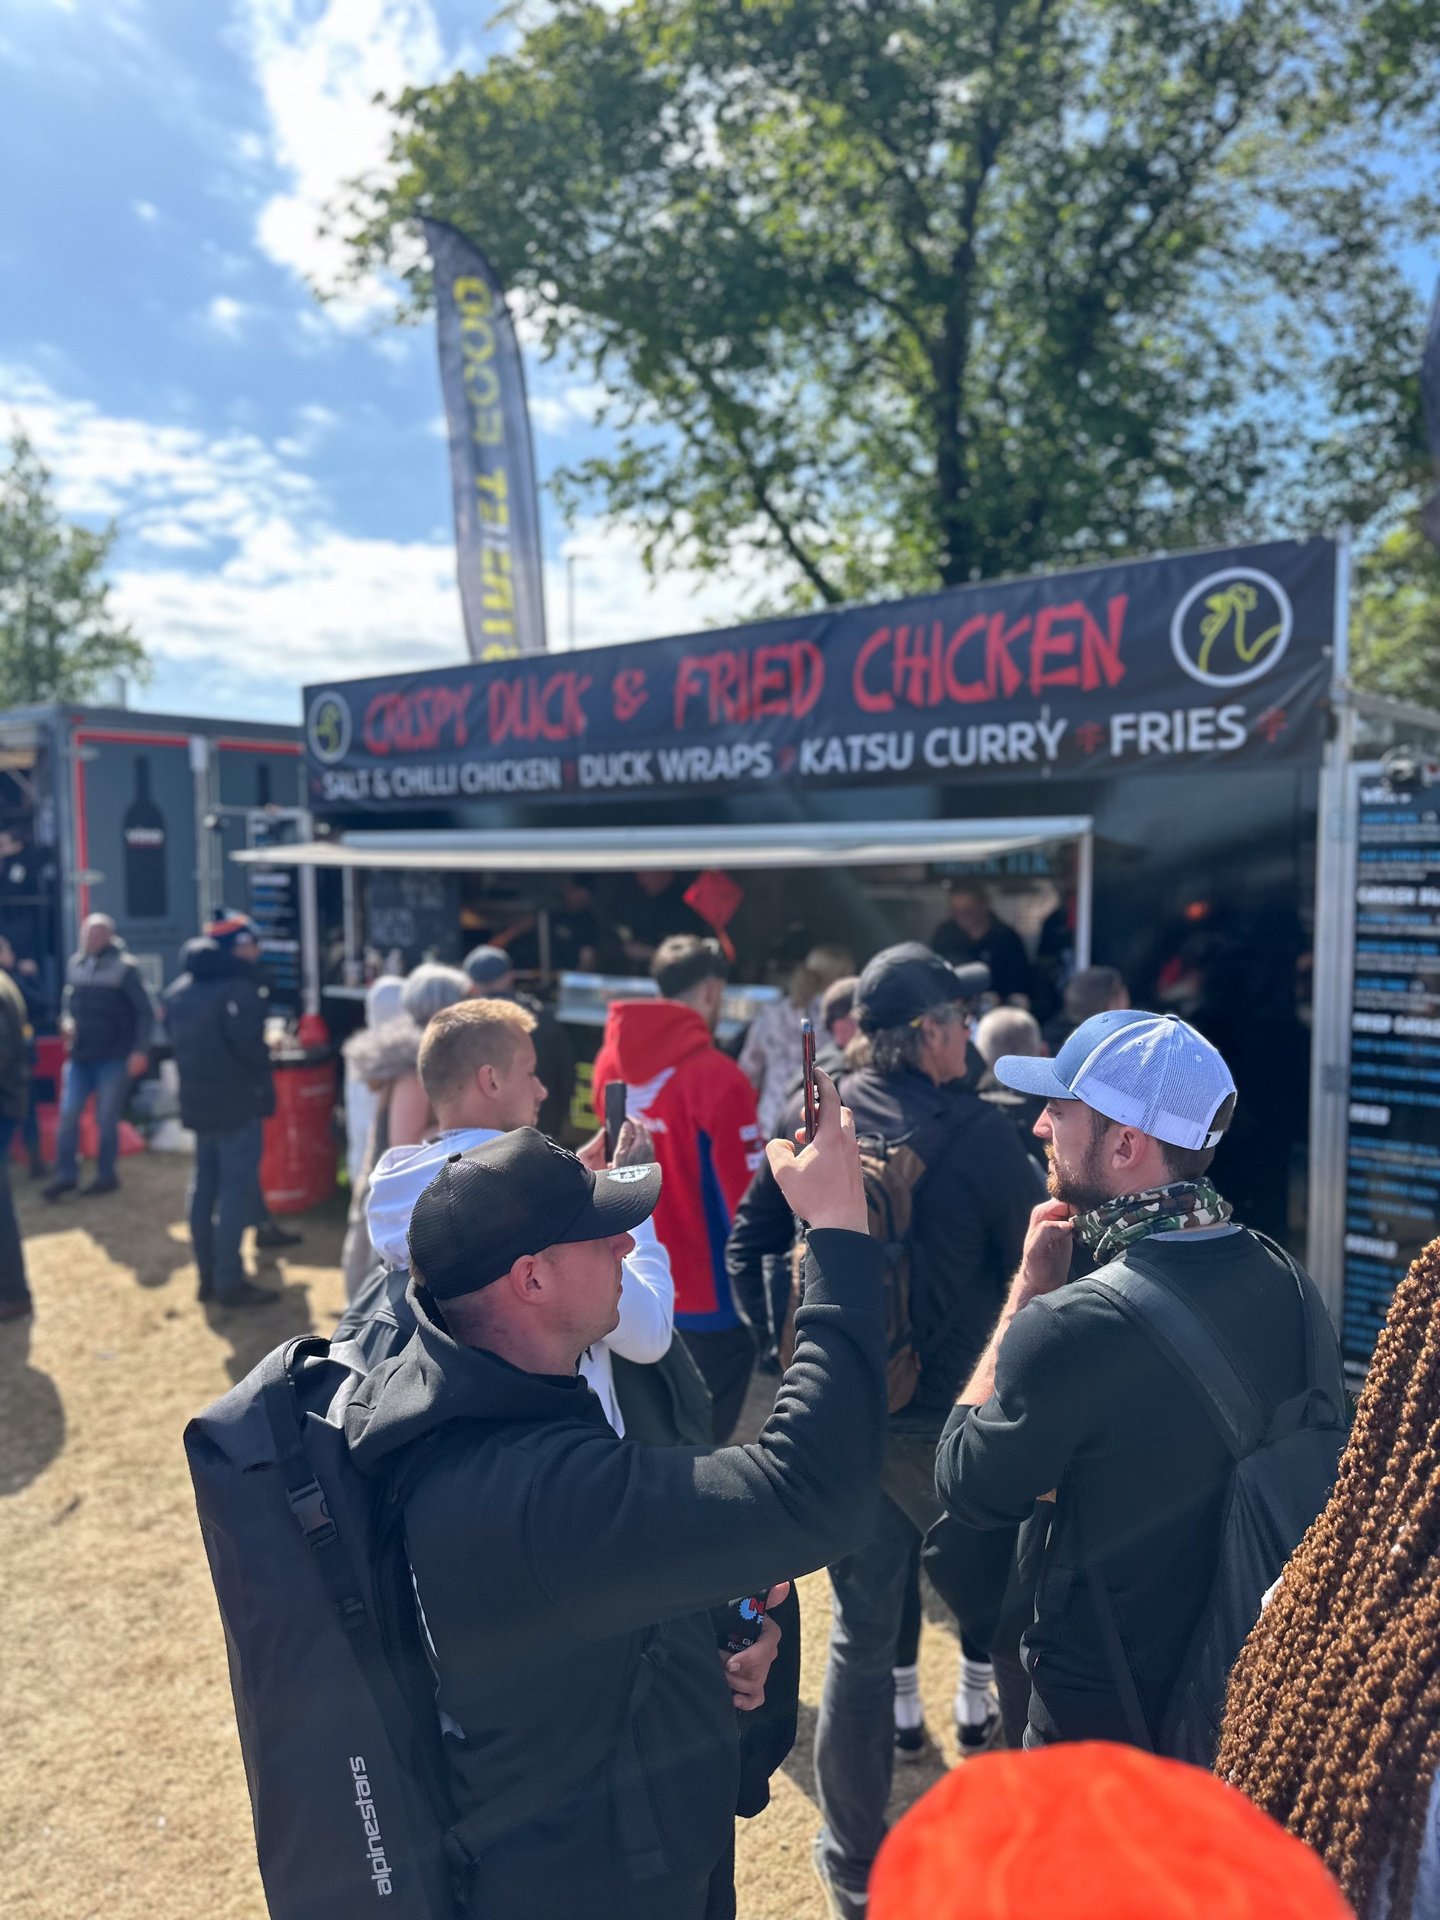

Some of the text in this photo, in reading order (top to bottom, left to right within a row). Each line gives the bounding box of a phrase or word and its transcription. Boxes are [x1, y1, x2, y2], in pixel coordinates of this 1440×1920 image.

[366, 595, 1129, 754] CRISPY DUCK & FRIED CHICKEN
[324, 706, 1246, 800] SALT & CHILLI CHICKEN DUCK WRAPS KATSU CURRY FRIES
[351, 1756, 392, 1895] alpinestars
